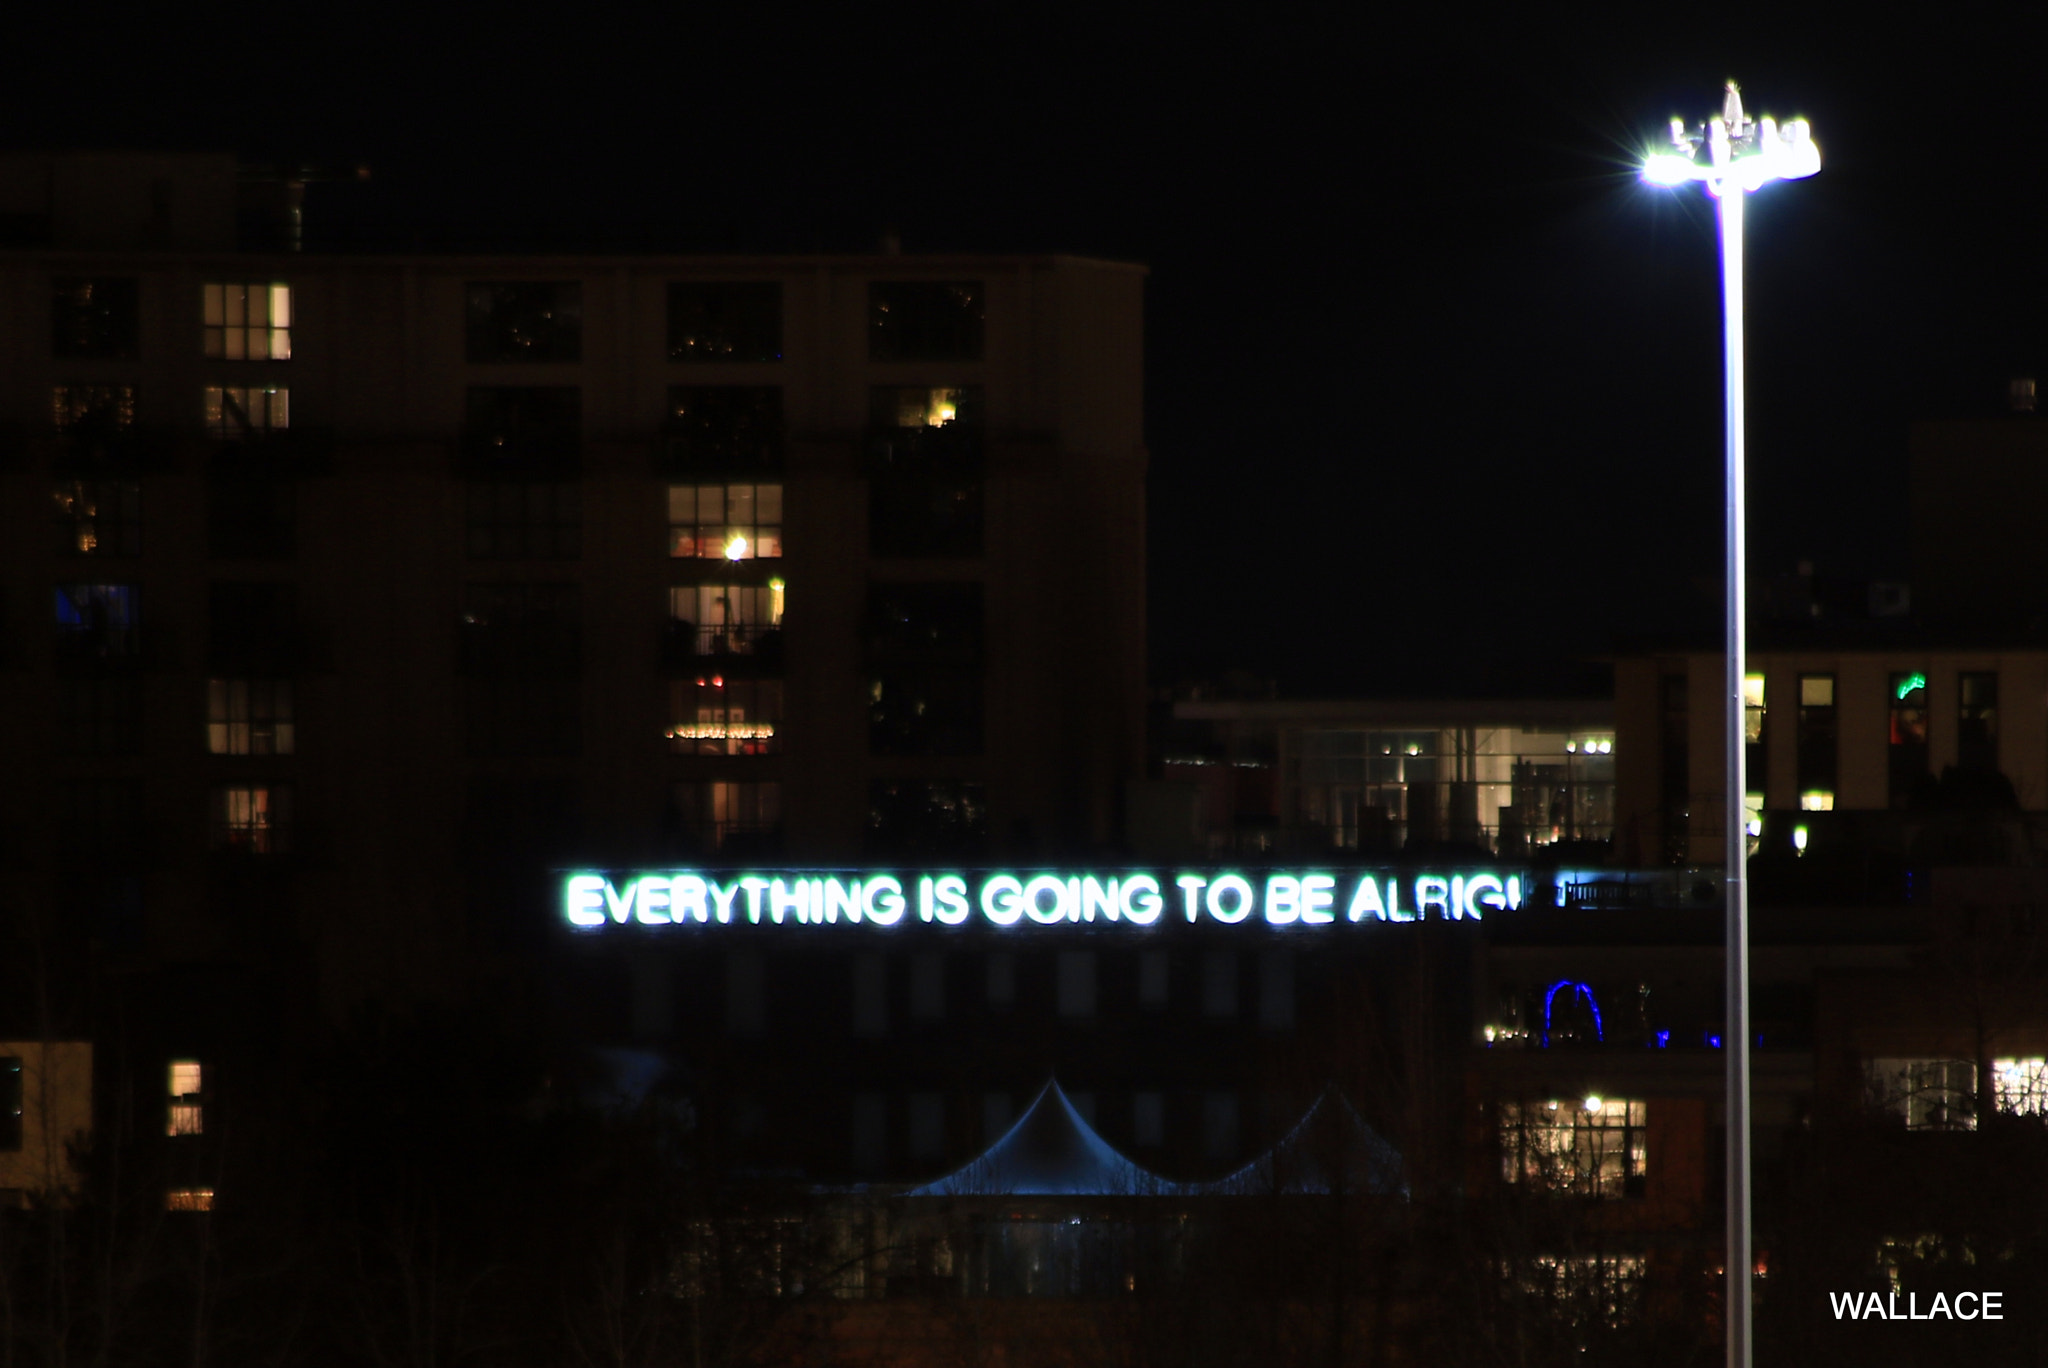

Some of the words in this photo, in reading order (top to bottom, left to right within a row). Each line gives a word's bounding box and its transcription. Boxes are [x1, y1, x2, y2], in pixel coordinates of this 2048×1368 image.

[567, 874, 906, 926] EVERYTHING
[919, 875, 970, 925] IS
[981, 874, 1163, 926] GOING
[1177, 874, 1254, 924] TO
[1265, 875, 1335, 925] BE
